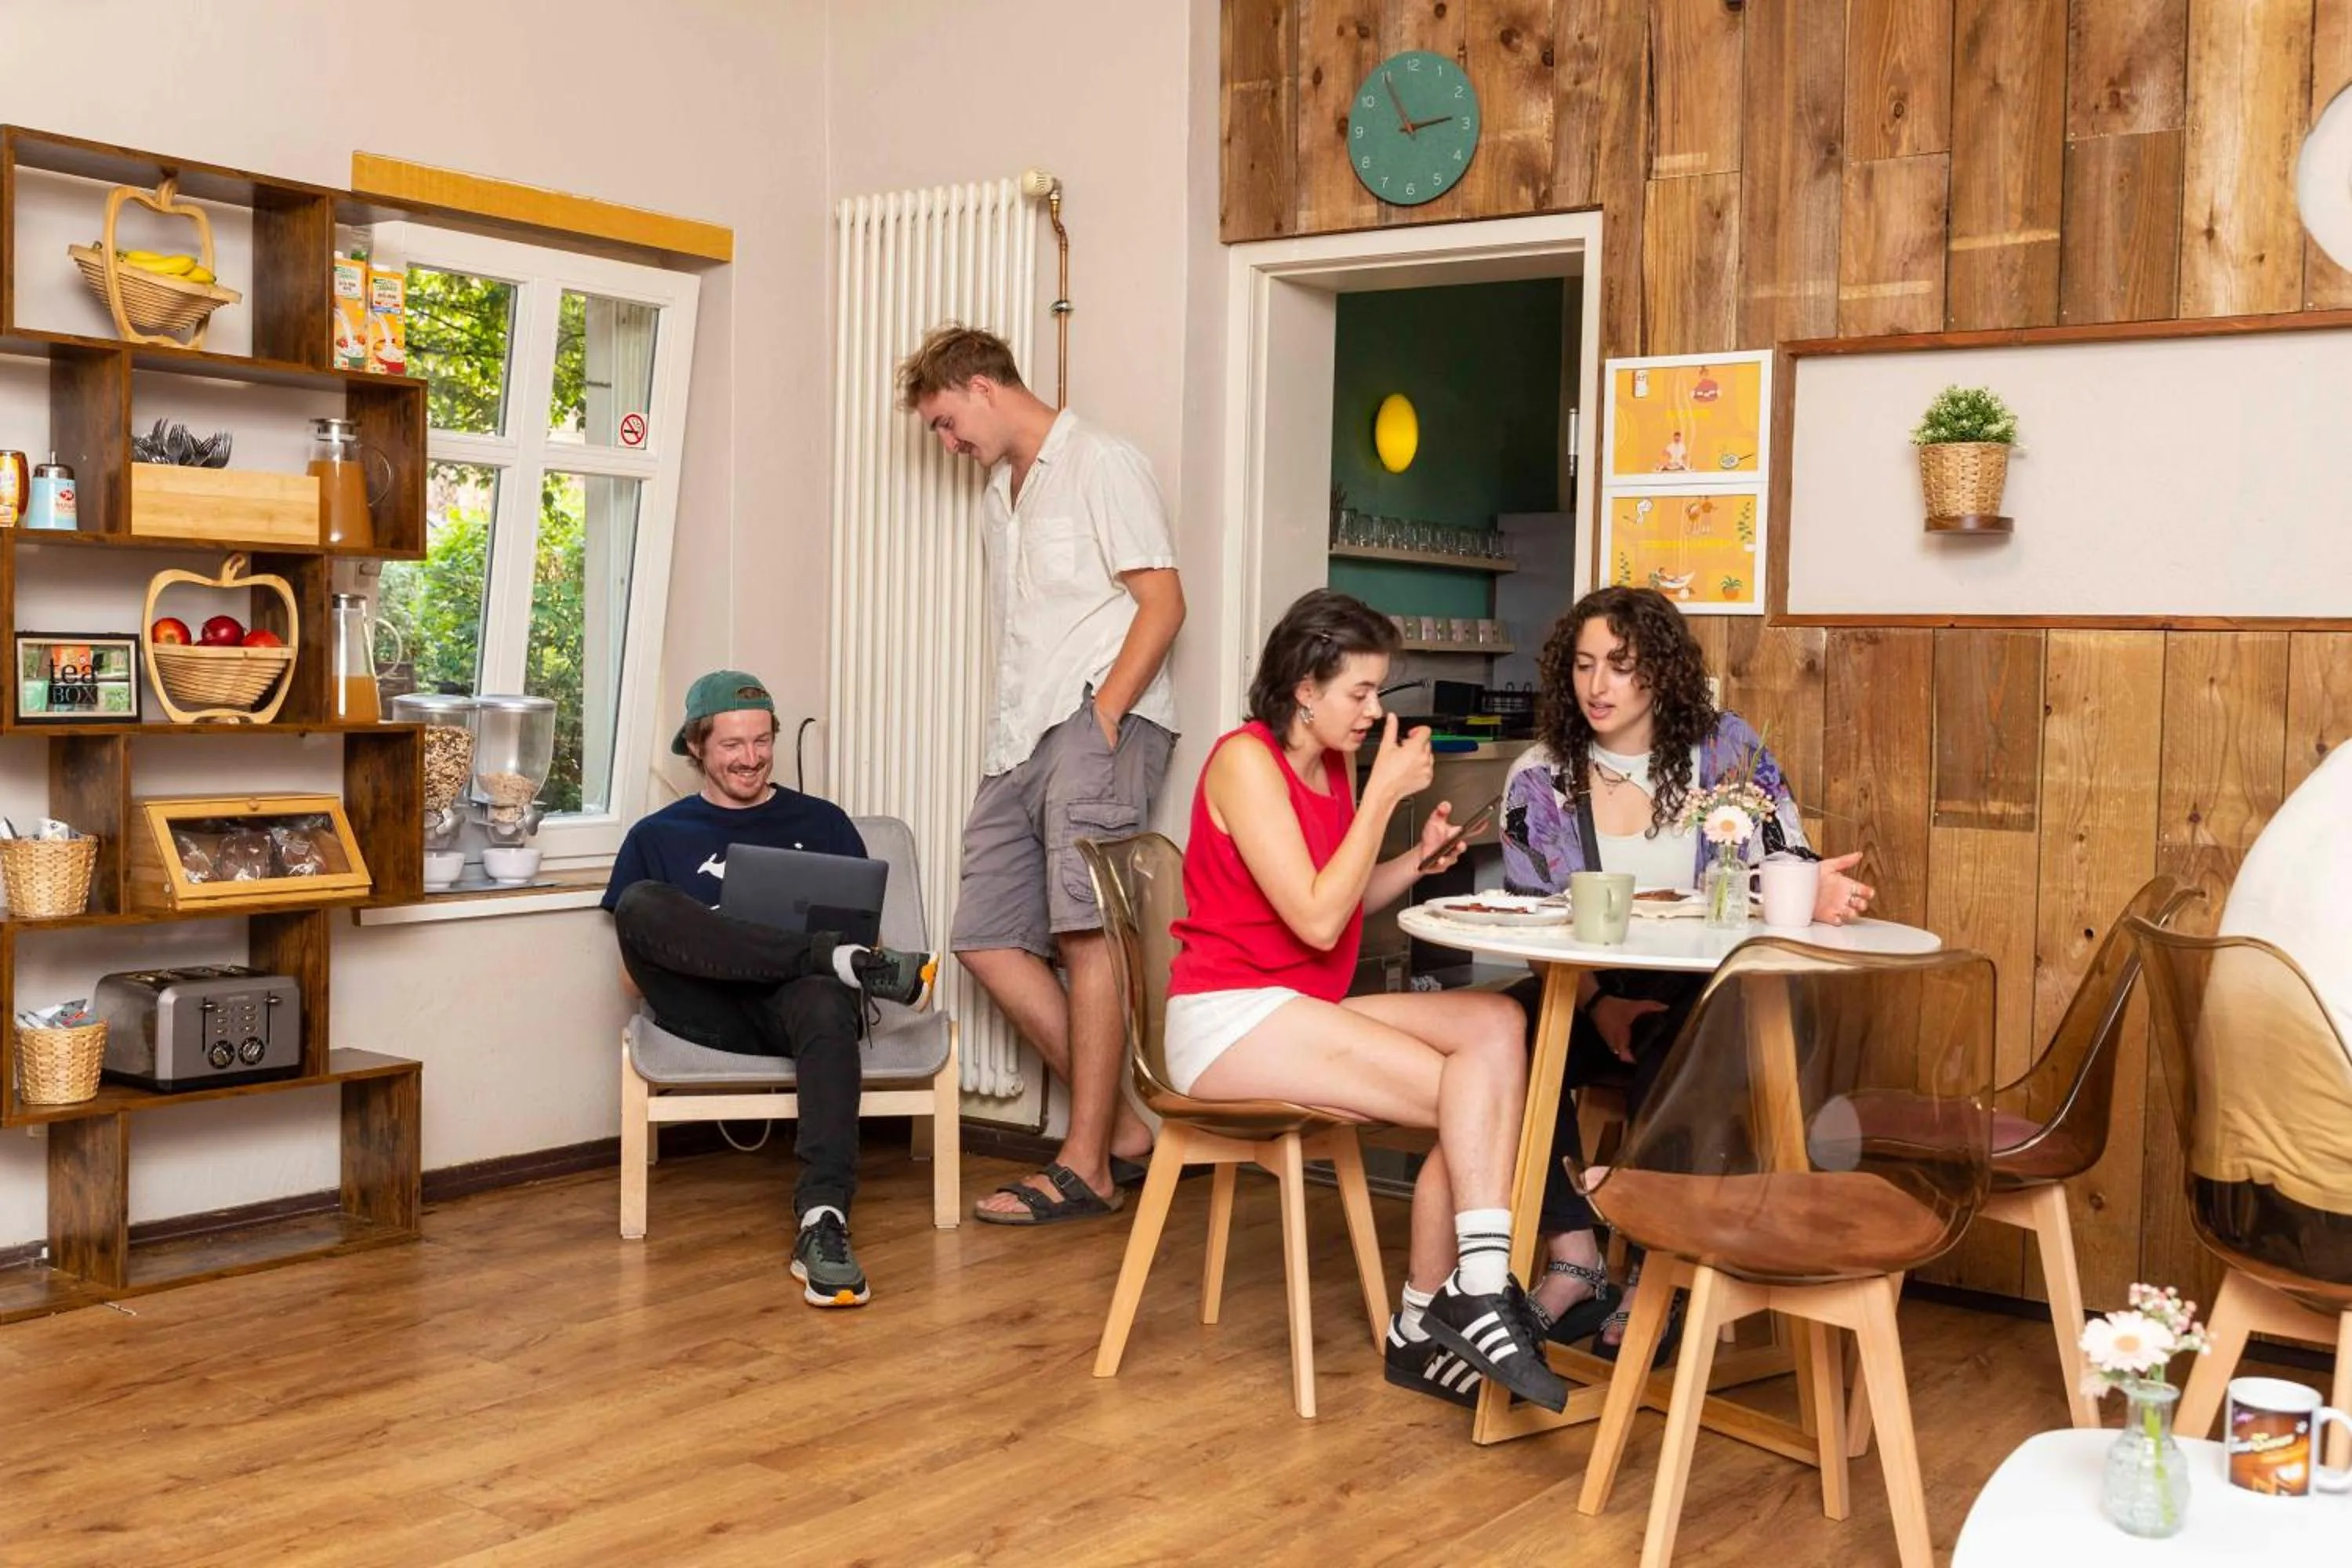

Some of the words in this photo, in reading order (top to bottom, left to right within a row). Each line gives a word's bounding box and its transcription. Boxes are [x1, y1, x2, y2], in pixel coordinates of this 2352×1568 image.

[1406, 59, 1420, 71] 12
[1437, 66, 1443, 76] 1
[1454, 85, 1465, 98] 2
[1362, 95, 1374, 107] 10
[1461, 117, 1471, 129] 3
[1355, 126, 1363, 138] 9
[1453, 149, 1461, 161] 4
[1361, 156, 1370, 169] 8
[1381, 176, 1389, 188] 7
[1433, 173, 1442, 186] 5
[1406, 183, 1415, 195] 6
[49, 659, 95, 684] tea
[53, 685, 96, 703] BOX
